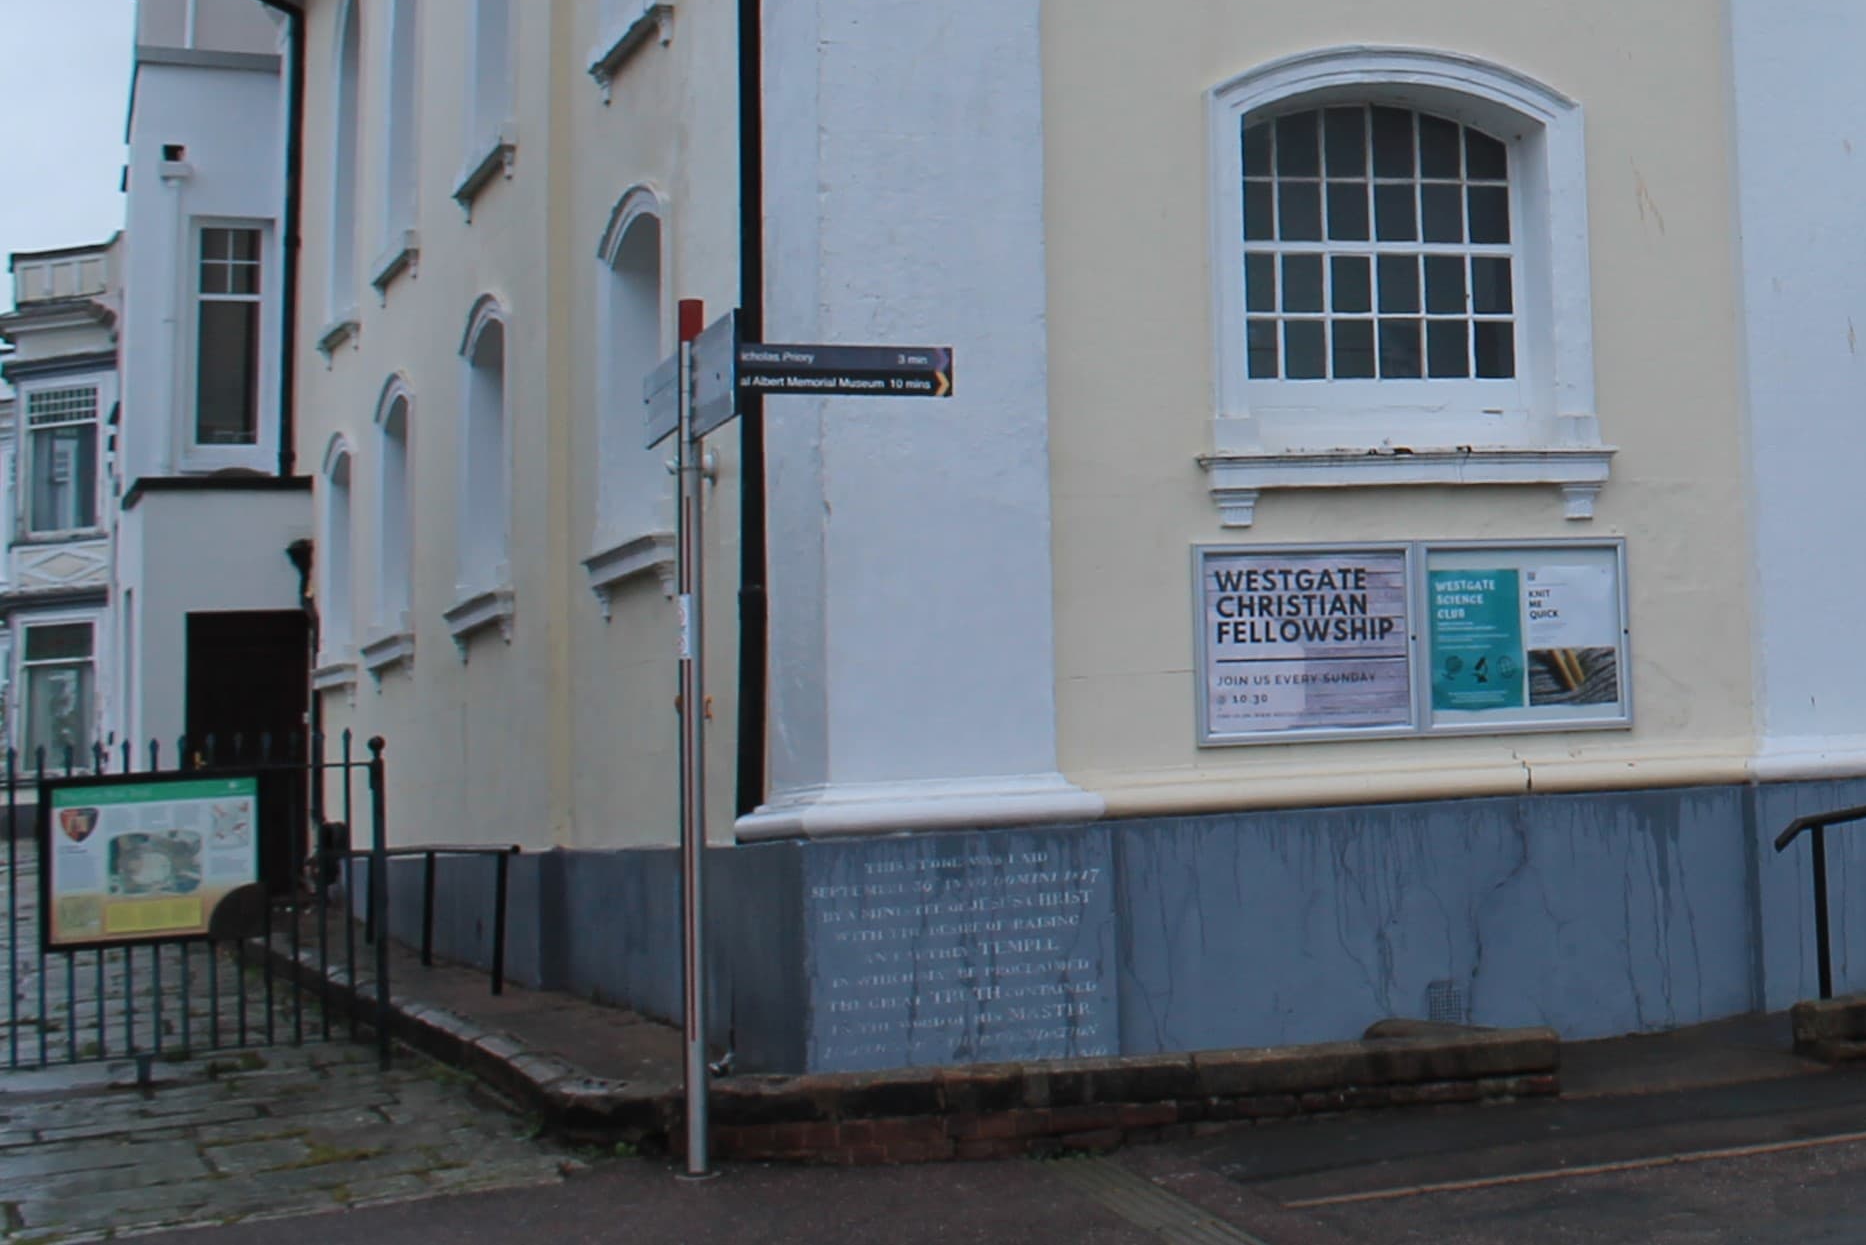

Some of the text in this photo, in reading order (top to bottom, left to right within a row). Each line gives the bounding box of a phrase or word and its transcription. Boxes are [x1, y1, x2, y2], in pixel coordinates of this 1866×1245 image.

[740, 351, 780, 362] icholas
[782, 351, 816, 365] Priory
[897, 354, 905, 364] 3
[752, 375, 785, 387] Albert
[787, 375, 836, 387] Memorial
[838, 377, 885, 388] Museum
[890, 378, 903, 388] 10
[905, 378, 931, 389] mins
[1215, 568, 1367, 592] WESTGATE
[1435, 579, 1496, 592] WESTGATE
[1436, 593, 1484, 605] SCIENCE
[1528, 589, 1550, 598] KNIT
[1216, 593, 1367, 617] CHRISTIAN
[1529, 600, 1542, 608] ME
[1437, 608, 1465, 620] CLUB
[1530, 609, 1559, 619] QUICK
[1217, 617, 1394, 644] FELLOWSHIP
[1217, 671, 1376, 686] JOIN US EVERY SUNDAY
